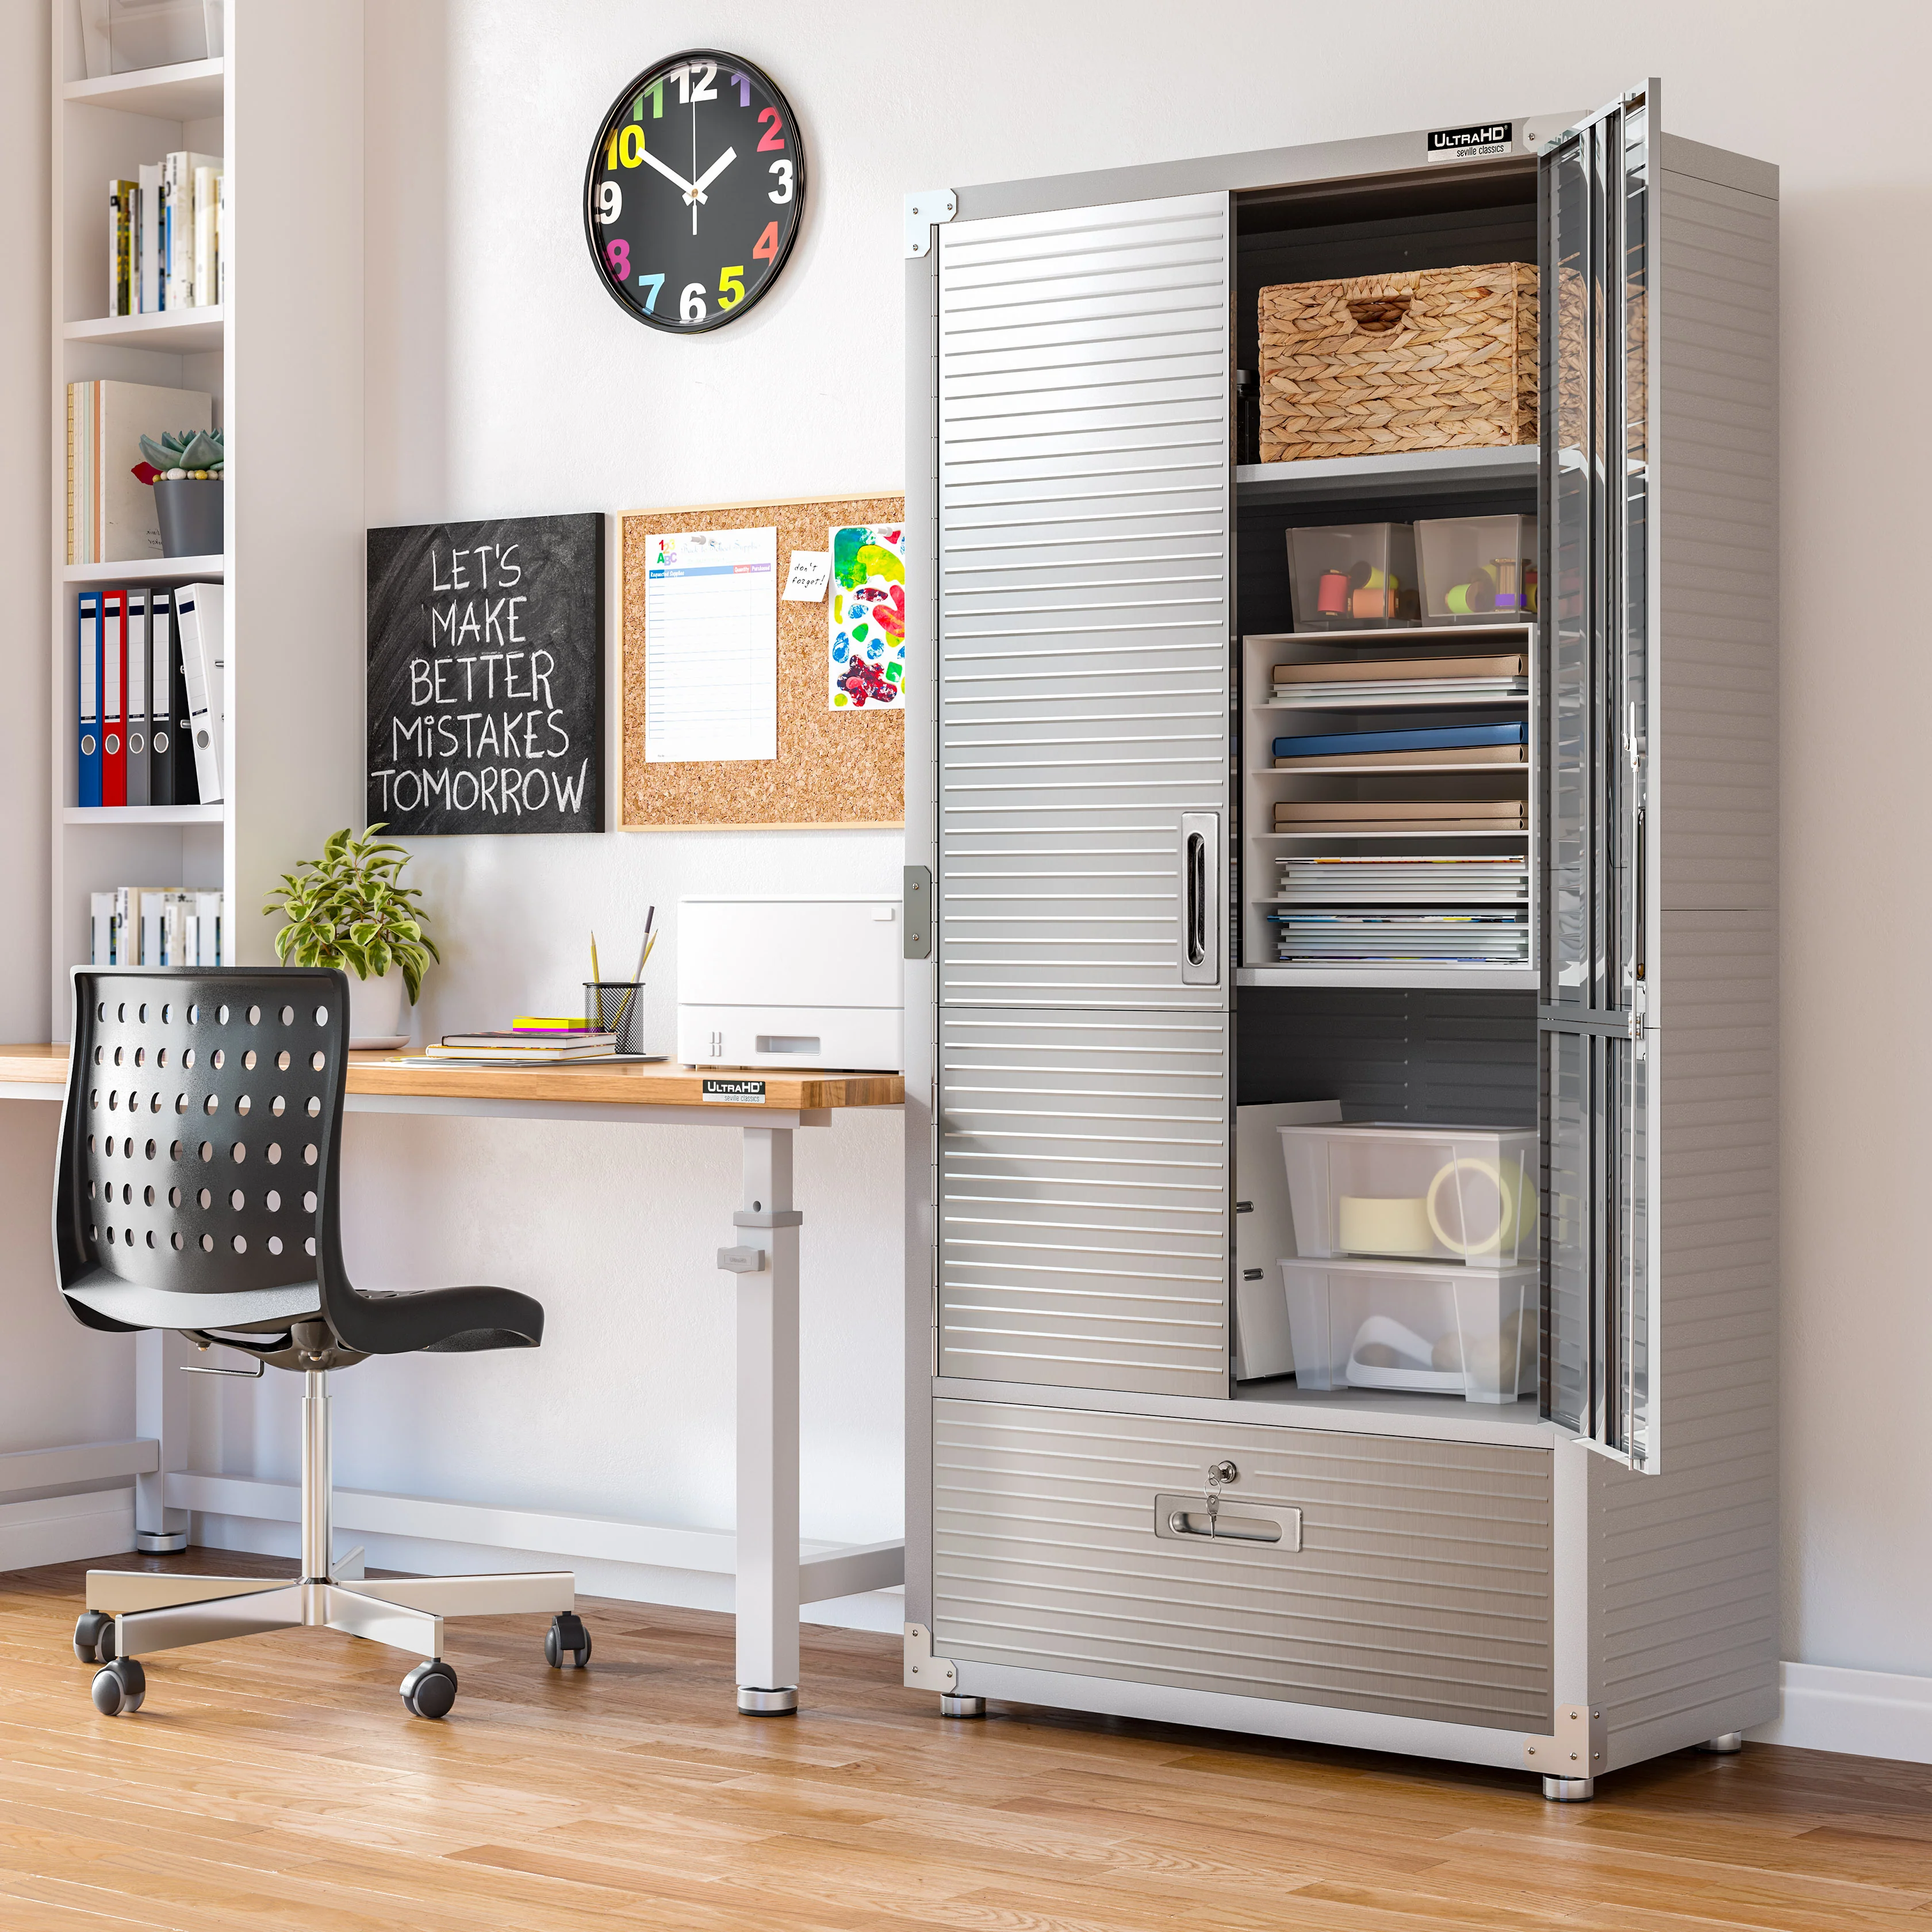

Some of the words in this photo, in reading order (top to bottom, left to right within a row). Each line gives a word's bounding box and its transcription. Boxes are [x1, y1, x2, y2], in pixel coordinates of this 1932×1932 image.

[634, 74, 664, 121] 11
[670, 63, 718, 103] 12
[731, 70, 750, 107] 1
[605, 124, 645, 171] 10
[756, 106, 785, 152] 2
[1456, 147, 1477, 157] seville
[1479, 145, 1504, 155] classics
[598, 181, 622, 225] 9
[768, 159, 793, 205] 3
[603, 239, 631, 282] 8
[753, 221, 779, 266] 4
[639, 273, 665, 316] 7
[679, 282, 707, 323] 6
[718, 265, 745, 311] 5
[432, 543, 521, 591] LET'S
[657, 552, 677, 566] ABC
[794, 562, 817, 572] don't
[432, 596, 527, 648] MAKE
[409, 649, 554, 710] BETTER
[371, 758, 588, 816] TOMORROW
